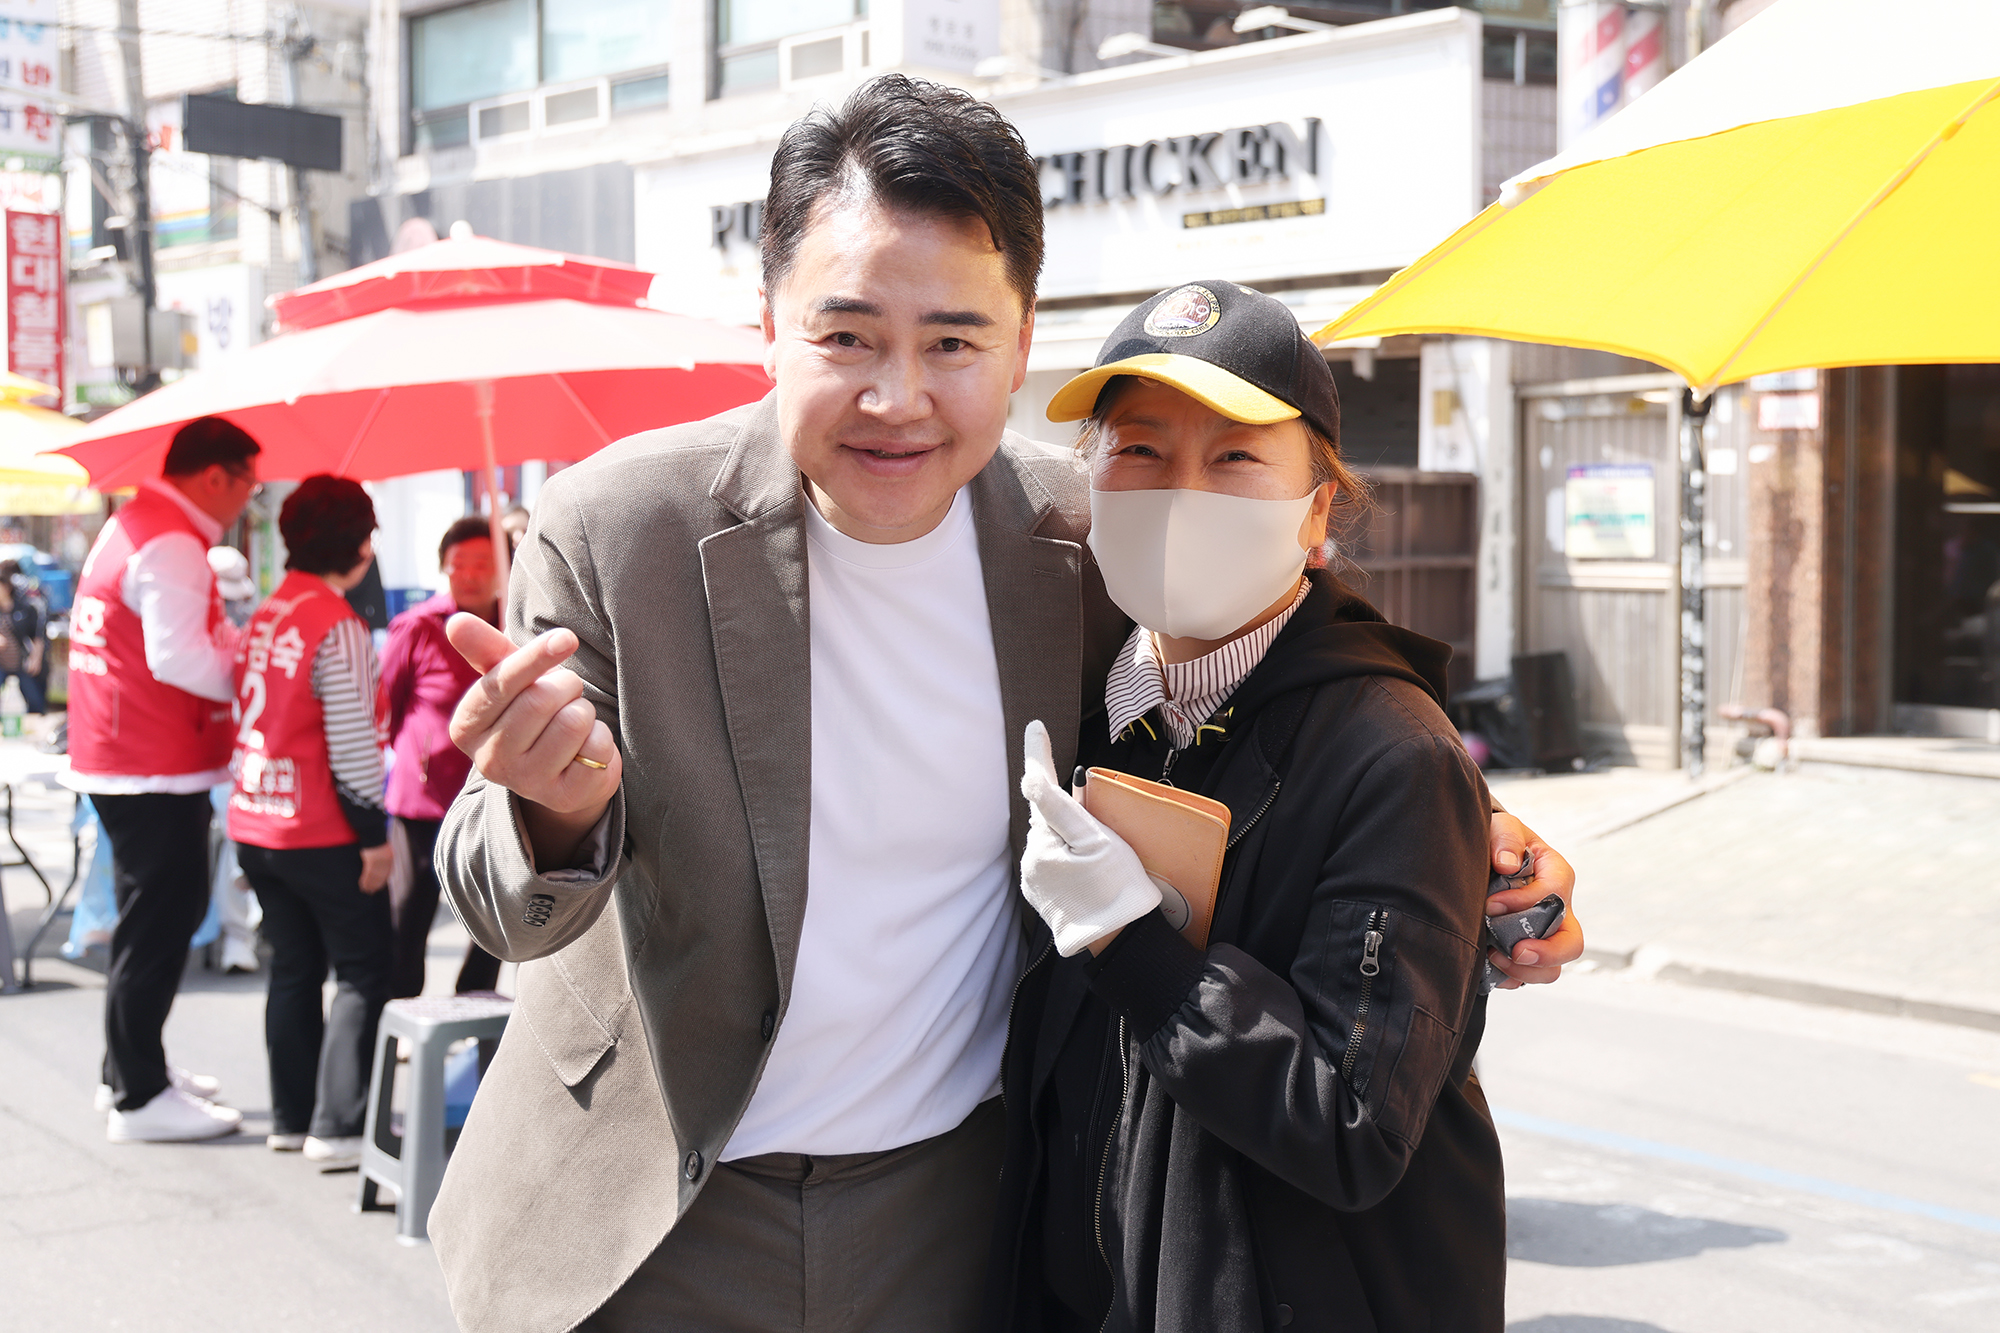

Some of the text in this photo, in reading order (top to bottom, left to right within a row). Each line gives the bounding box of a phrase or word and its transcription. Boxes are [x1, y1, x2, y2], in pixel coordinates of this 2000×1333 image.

[1036, 116, 1322, 210] CHICKEN
[237, 671, 266, 747] 2
[1519, 917, 1534, 935] K2
